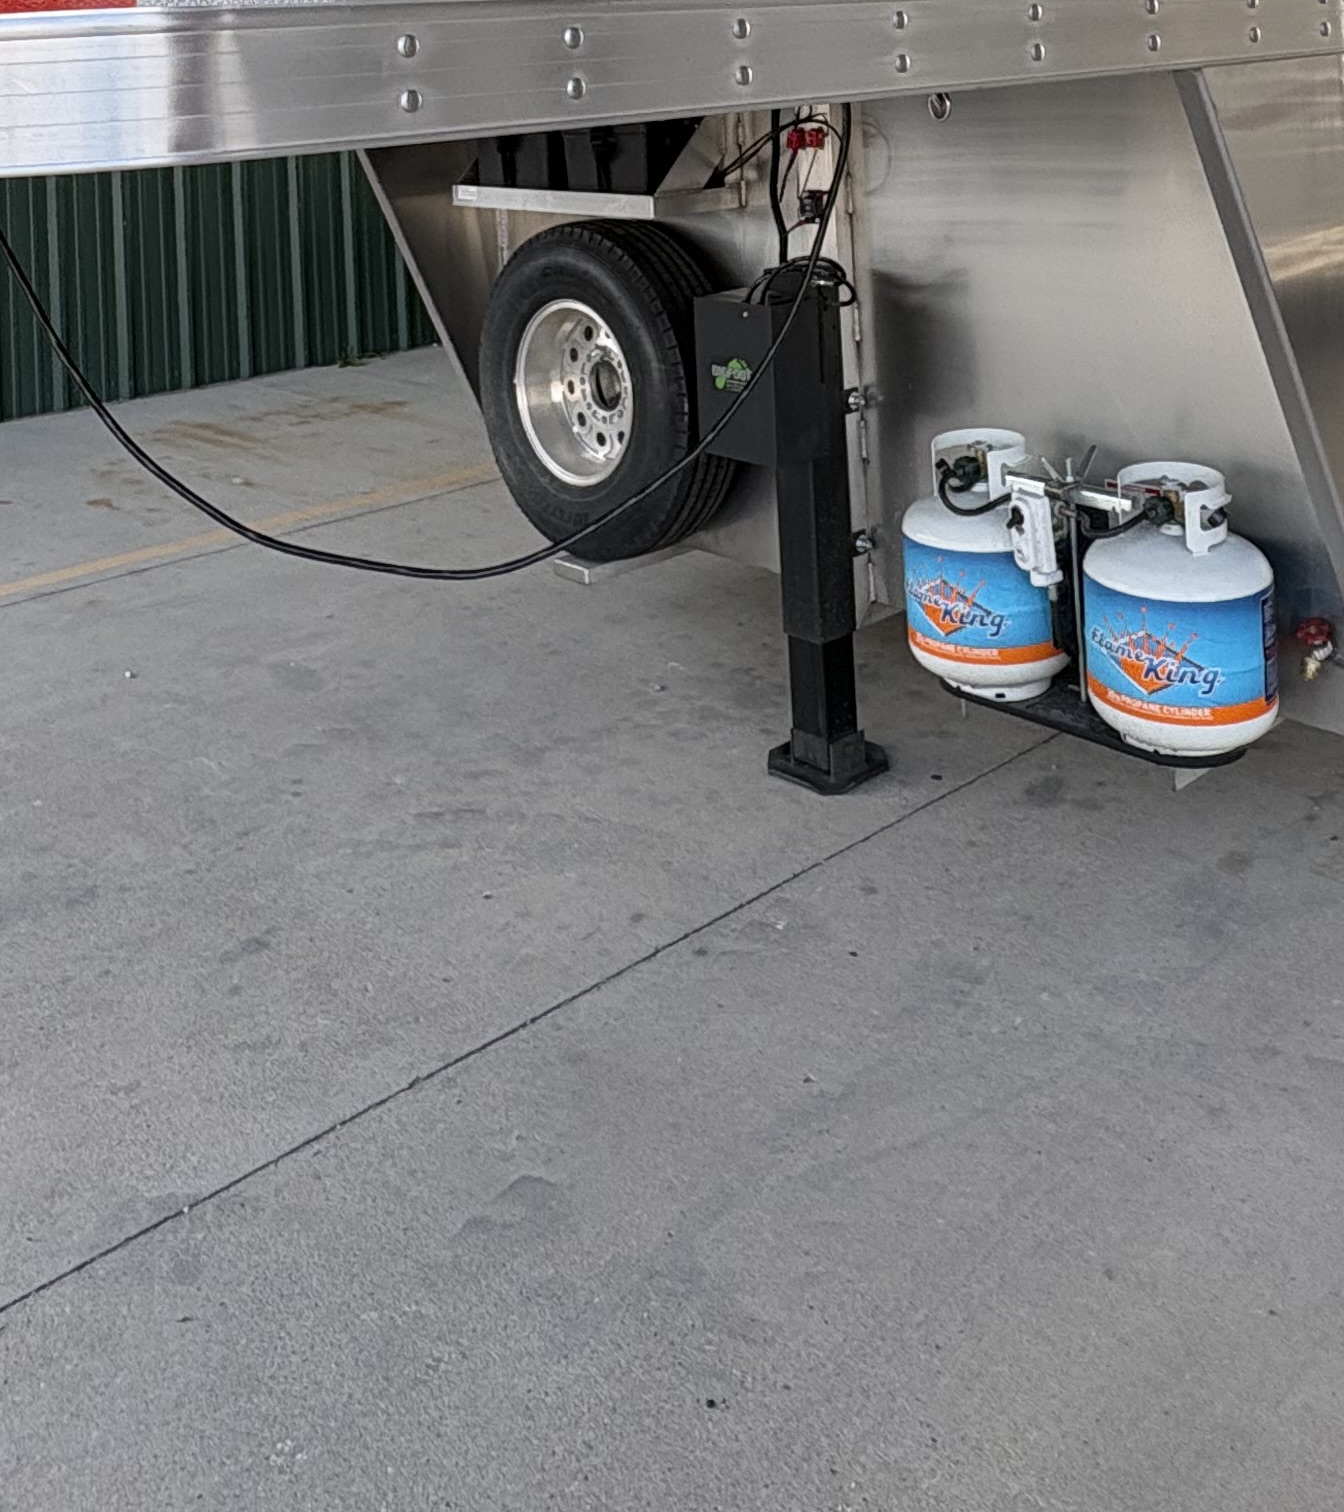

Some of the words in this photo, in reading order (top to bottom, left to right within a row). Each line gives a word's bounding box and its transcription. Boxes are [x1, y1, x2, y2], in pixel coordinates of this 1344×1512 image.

[941, 602, 1006, 638] King
[1090, 627, 1146, 664] Flame
[1142, 657, 1222, 697] King
